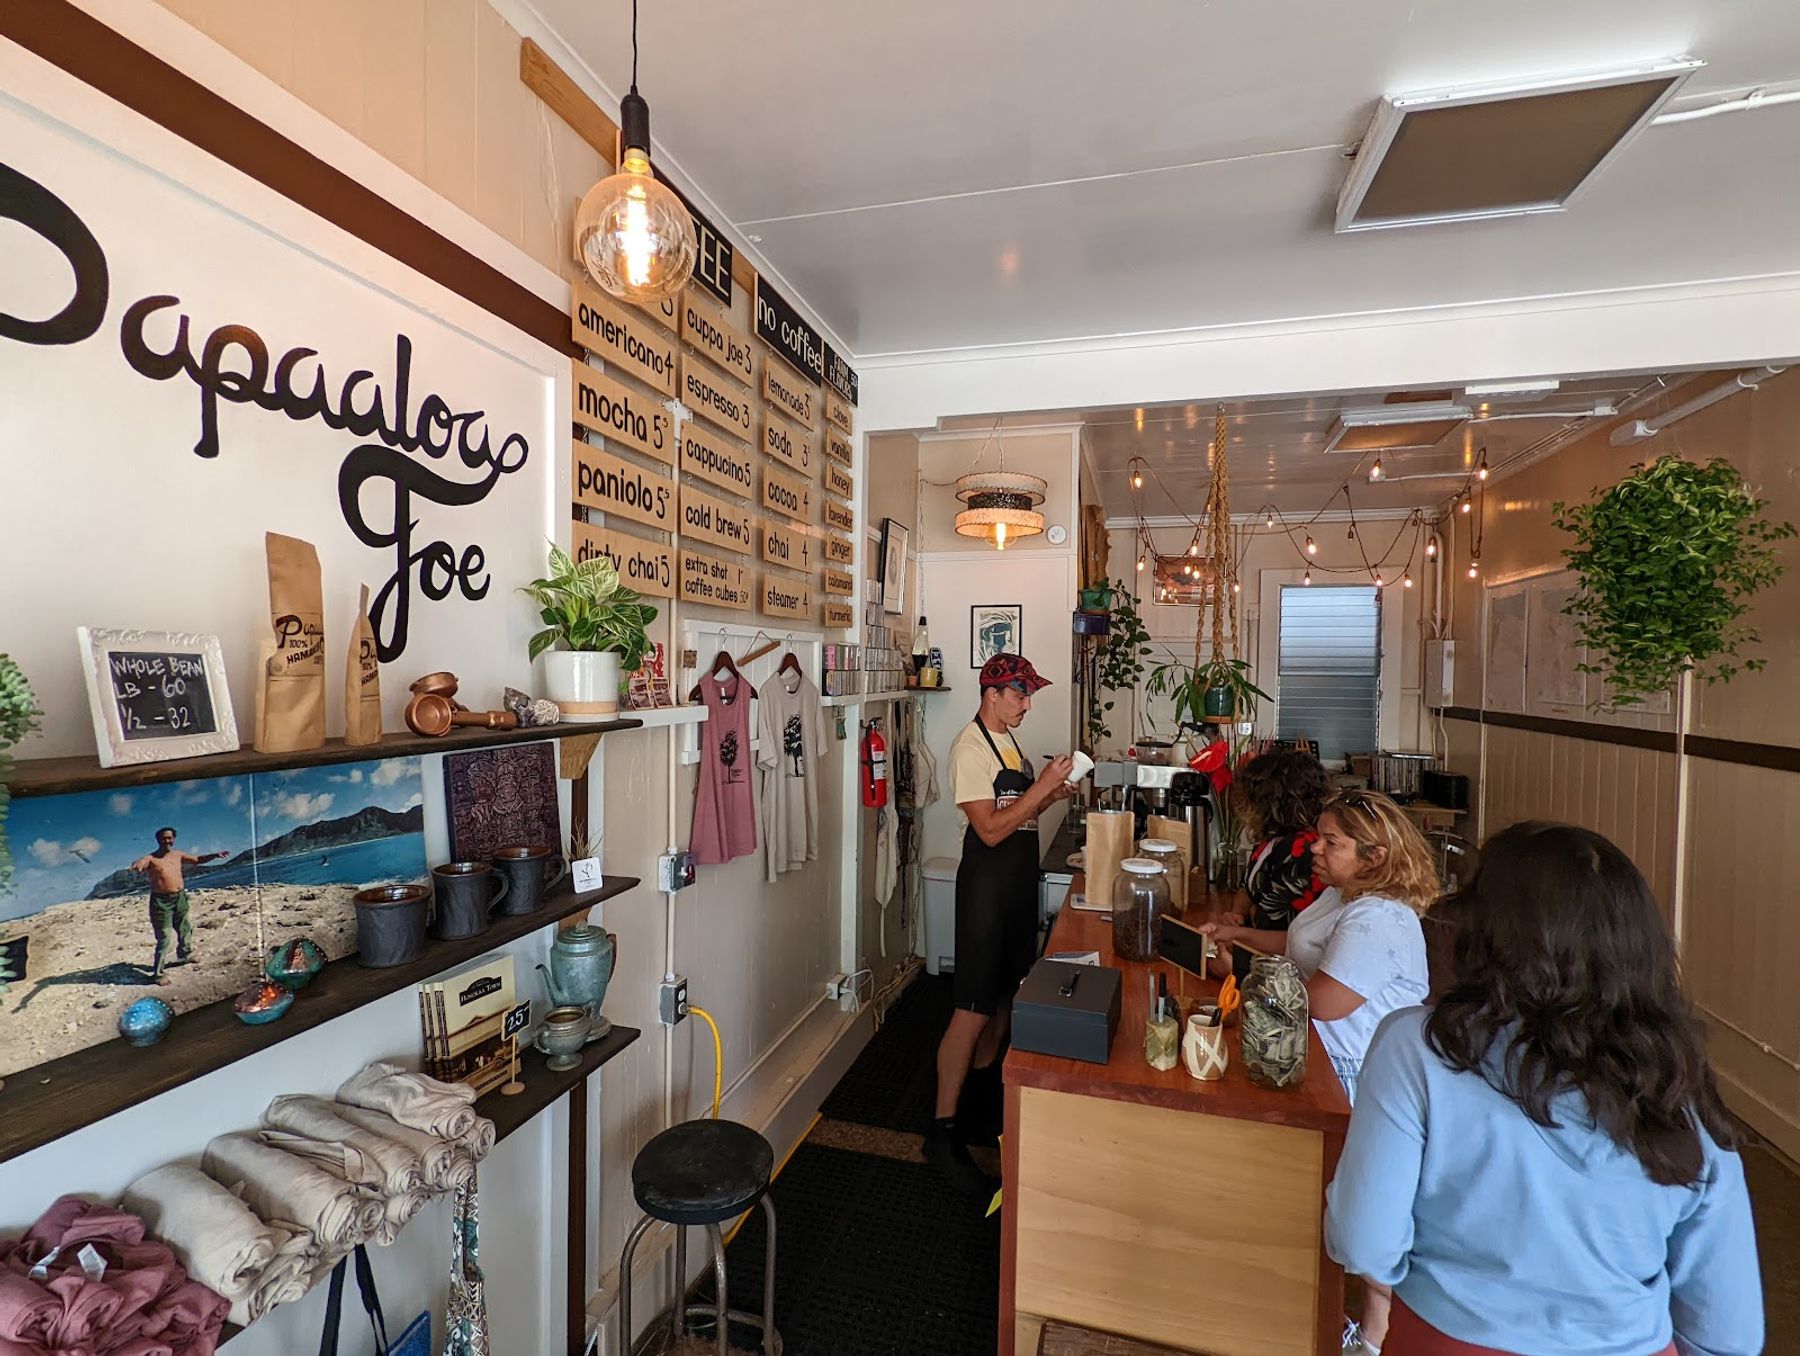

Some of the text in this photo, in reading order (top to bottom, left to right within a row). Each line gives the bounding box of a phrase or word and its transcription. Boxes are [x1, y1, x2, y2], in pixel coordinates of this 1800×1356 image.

[578, 301, 674, 386] americano 4
[687, 308, 752, 375] cuppa joe 3
[758, 296, 822, 374] no coffee
[687, 374, 750, 429] espresso 3
[768, 371, 804, 416] lemonade
[578, 382, 648, 443] mocha
[768, 427, 793, 459] soda
[686, 439, 751, 488] cappucino 5
[831, 466, 850, 495] honey
[578, 460, 653, 513] paniolo
[768, 481, 809, 515] cocoa 4
[686, 503, 750, 545] cold brew 5
[338, 443, 502, 664] Joe
[768, 531, 808, 566] chai 4
[831, 537, 851, 560] ginger
[628, 551, 659, 582] chai
[661, 554, 670, 588] 5
[685, 555, 708, 575] extra
[711, 561, 728, 580] shot
[685, 577, 713, 598] coffee
[715, 584, 738, 603] cubes
[767, 586, 808, 616] steamer 4
[109, 656, 204, 679] WHOLE BEAN
[113, 681, 141, 700] LB
[161, 675, 186, 698] 60
[168, 706, 191, 729] 32
